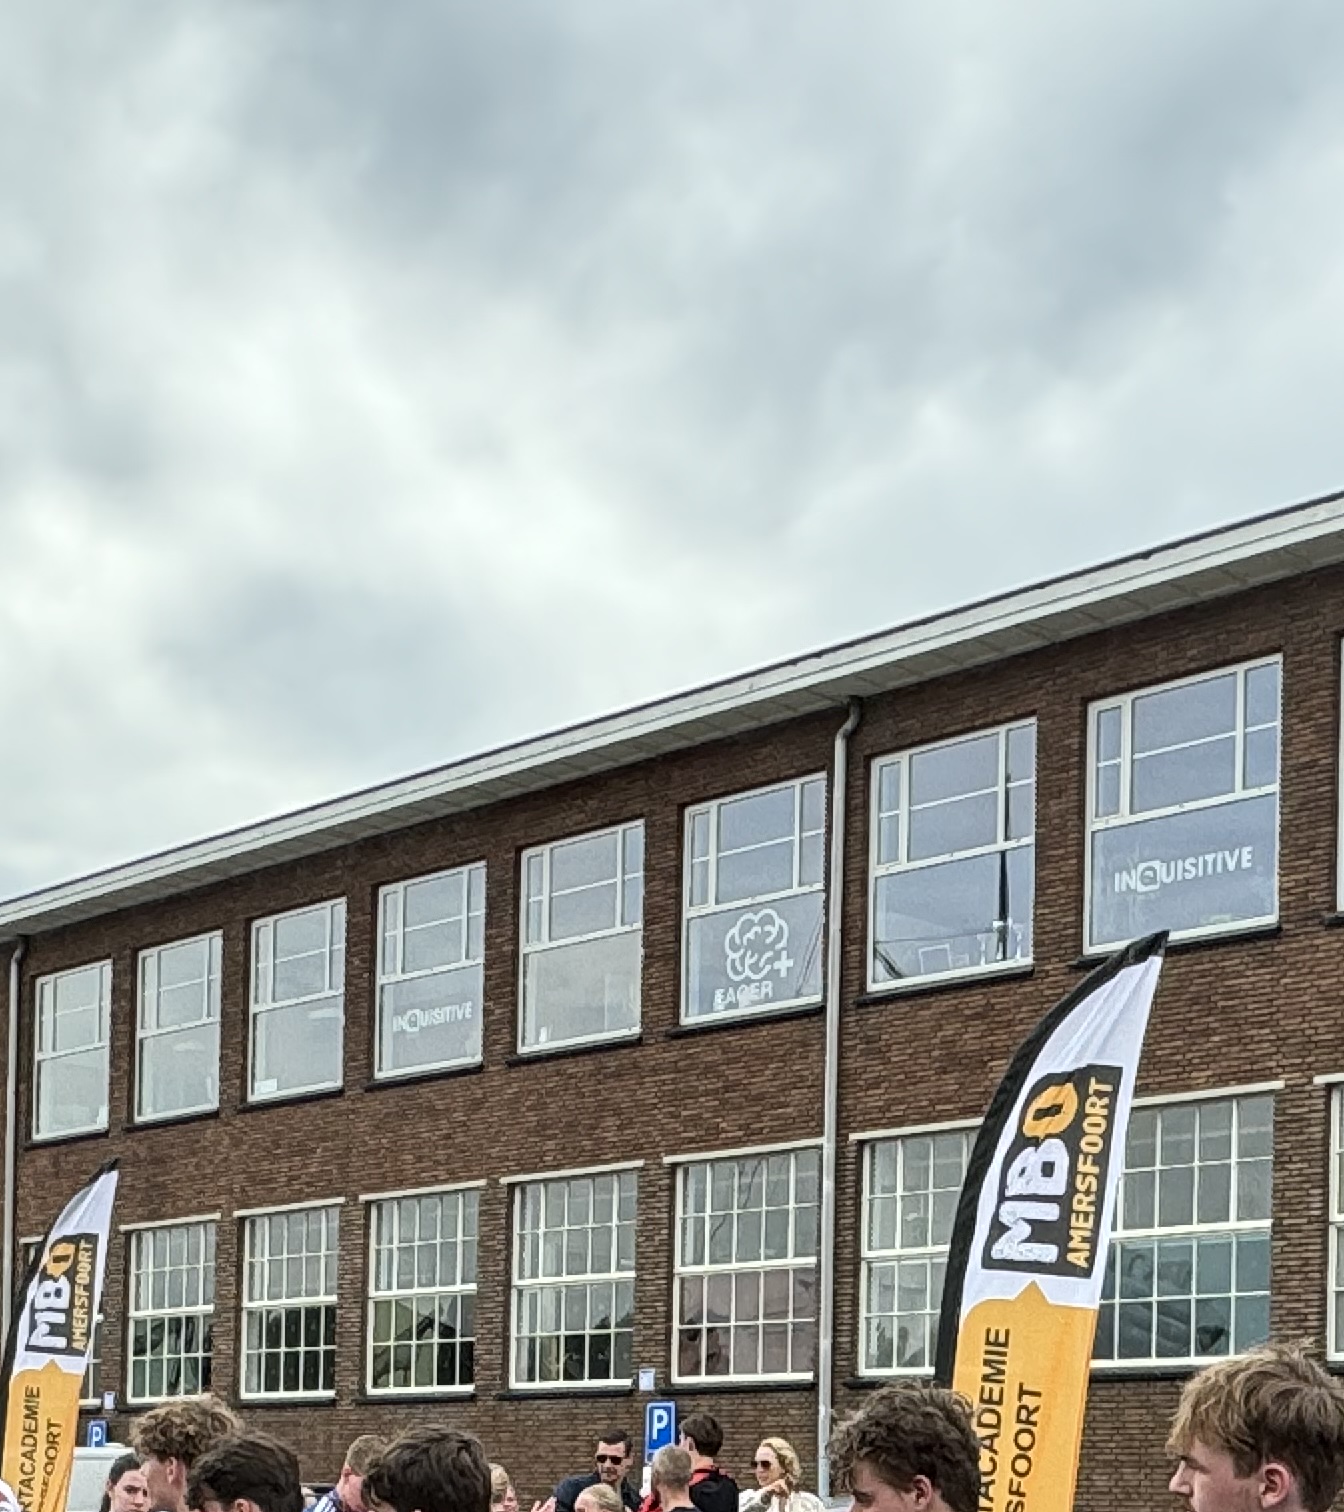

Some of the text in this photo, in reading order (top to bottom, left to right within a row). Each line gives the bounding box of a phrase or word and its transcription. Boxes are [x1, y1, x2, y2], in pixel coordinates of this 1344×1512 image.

[1113, 845, 1254, 894] INQUISITIVE
[714, 980, 773, 1013] EAGER
[991, 1083, 1079, 1264] MBO
[1066, 1077, 1114, 1268] AMERSFOORT
[28, 1242, 76, 1350] MBO
[71, 1238, 94, 1352] AMERSFOORT
[653, 1409, 668, 1439] P
